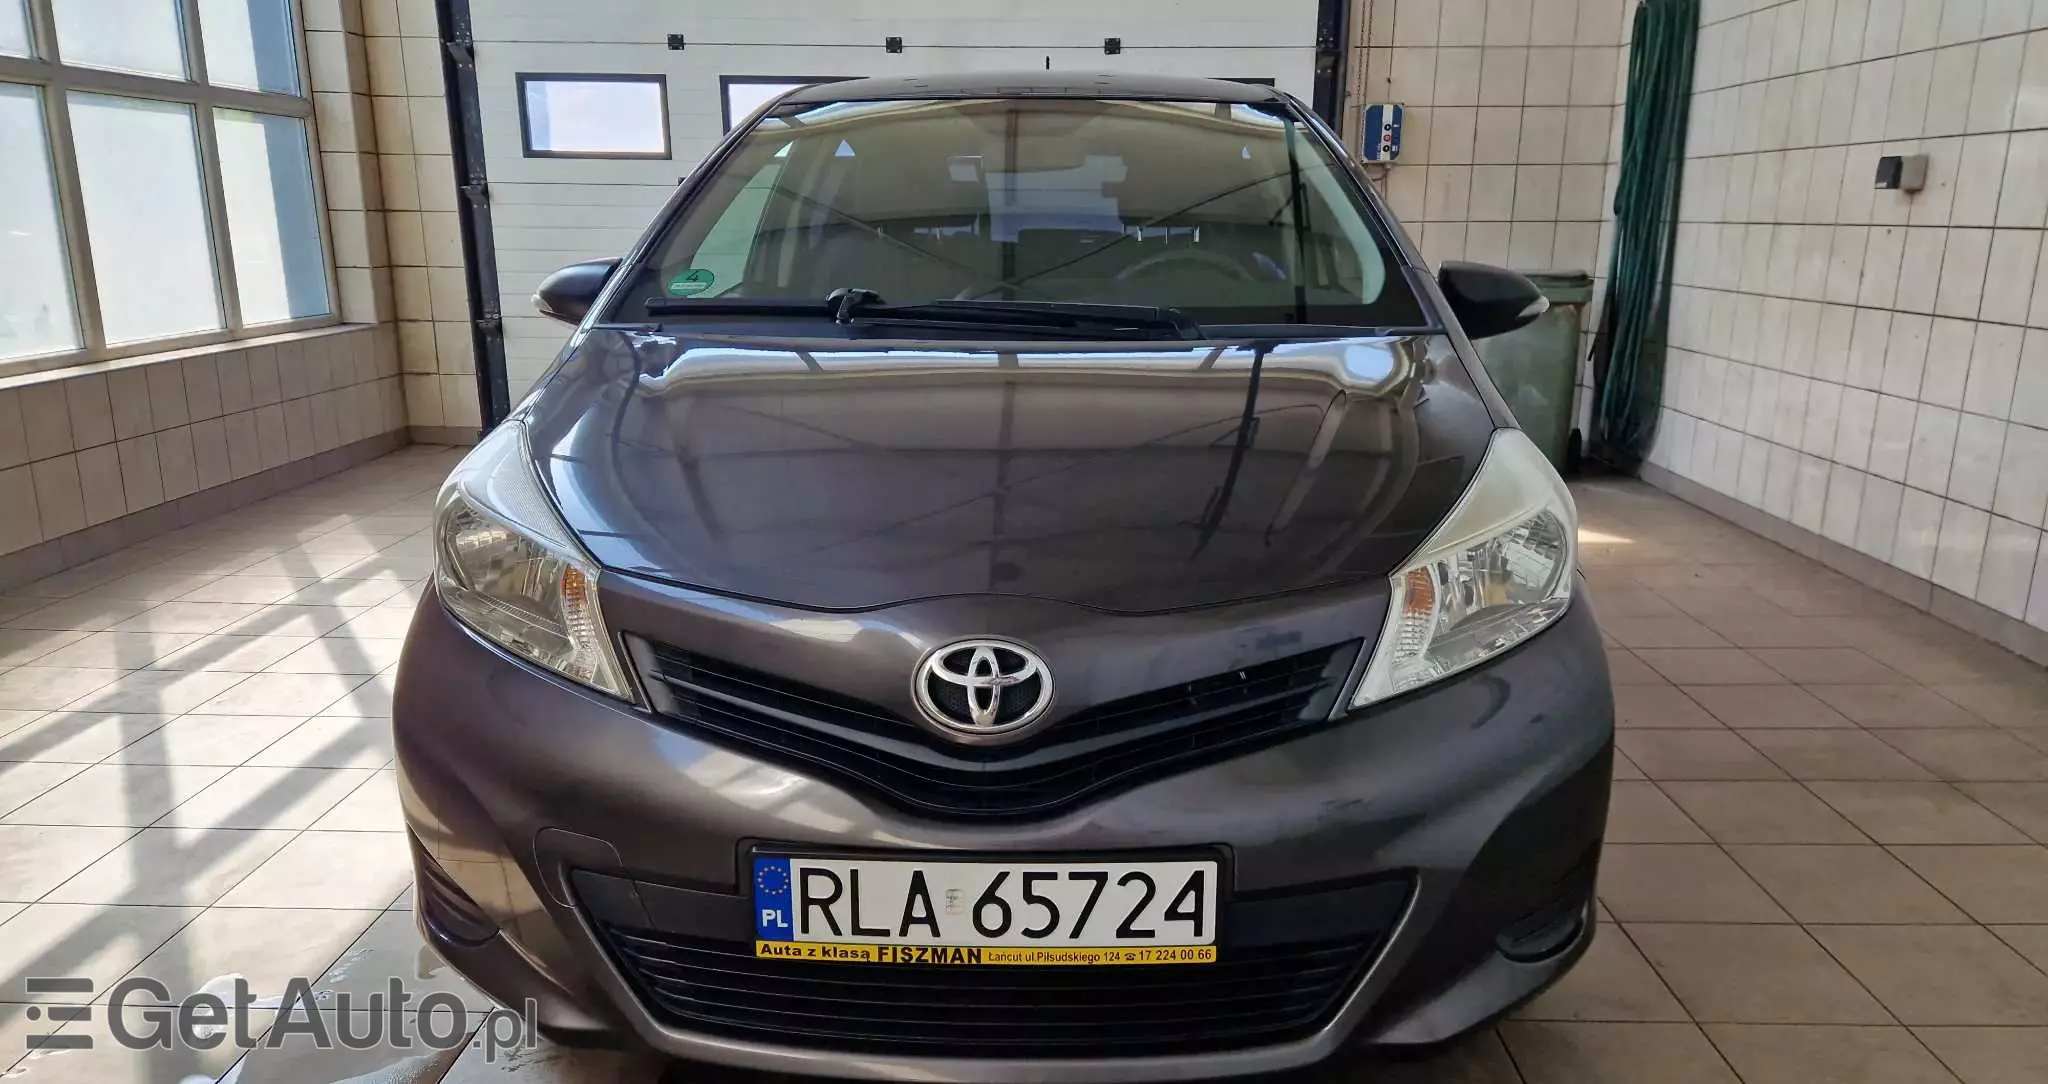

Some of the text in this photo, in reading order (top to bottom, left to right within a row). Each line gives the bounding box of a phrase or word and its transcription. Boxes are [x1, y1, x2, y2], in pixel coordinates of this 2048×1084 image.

[686, 269, 699, 282] 4
[799, 867, 1205, 940] RLA 65724
[762, 909, 789, 928] PL
[760, 943, 802, 957] Auta
[807, 949, 817, 958] z
[877, 946, 982, 964] FISZMAN
[1103, 951, 1121, 962] 124
[1139, 950, 1152, 961] 17
[1155, 949, 1177, 961] 224
[1180, 949, 1194, 960] 00
[1197, 948, 1212, 960] 66
